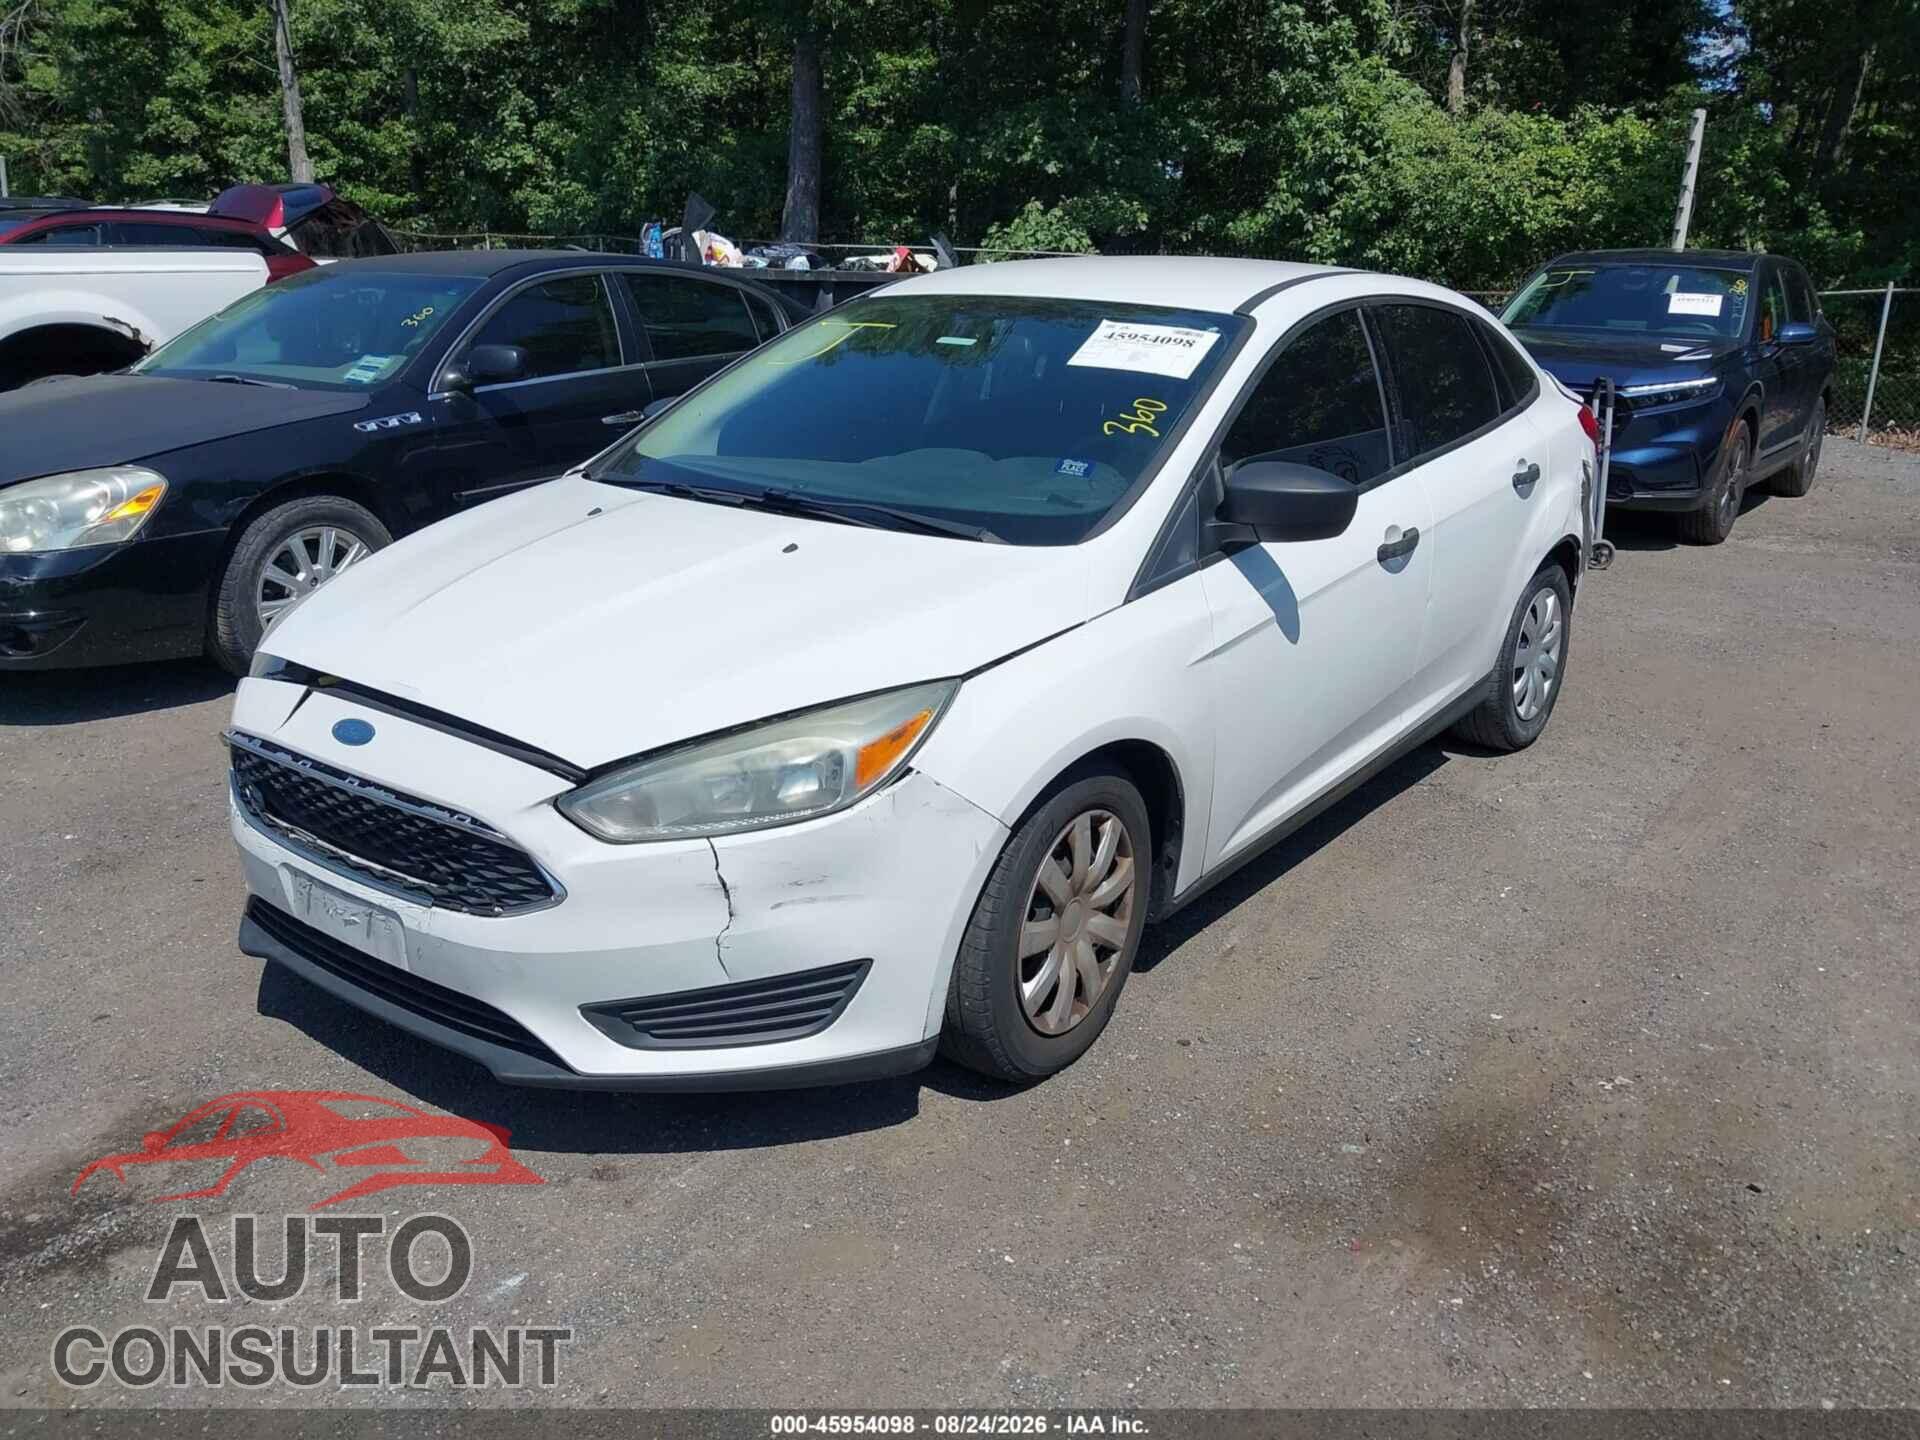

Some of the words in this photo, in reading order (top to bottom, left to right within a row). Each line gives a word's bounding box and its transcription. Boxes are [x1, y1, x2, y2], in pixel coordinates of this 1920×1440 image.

[401, 306, 434, 328] 360
[1104, 331, 1197, 349] 45954098
[1103, 398, 1168, 437] 360
